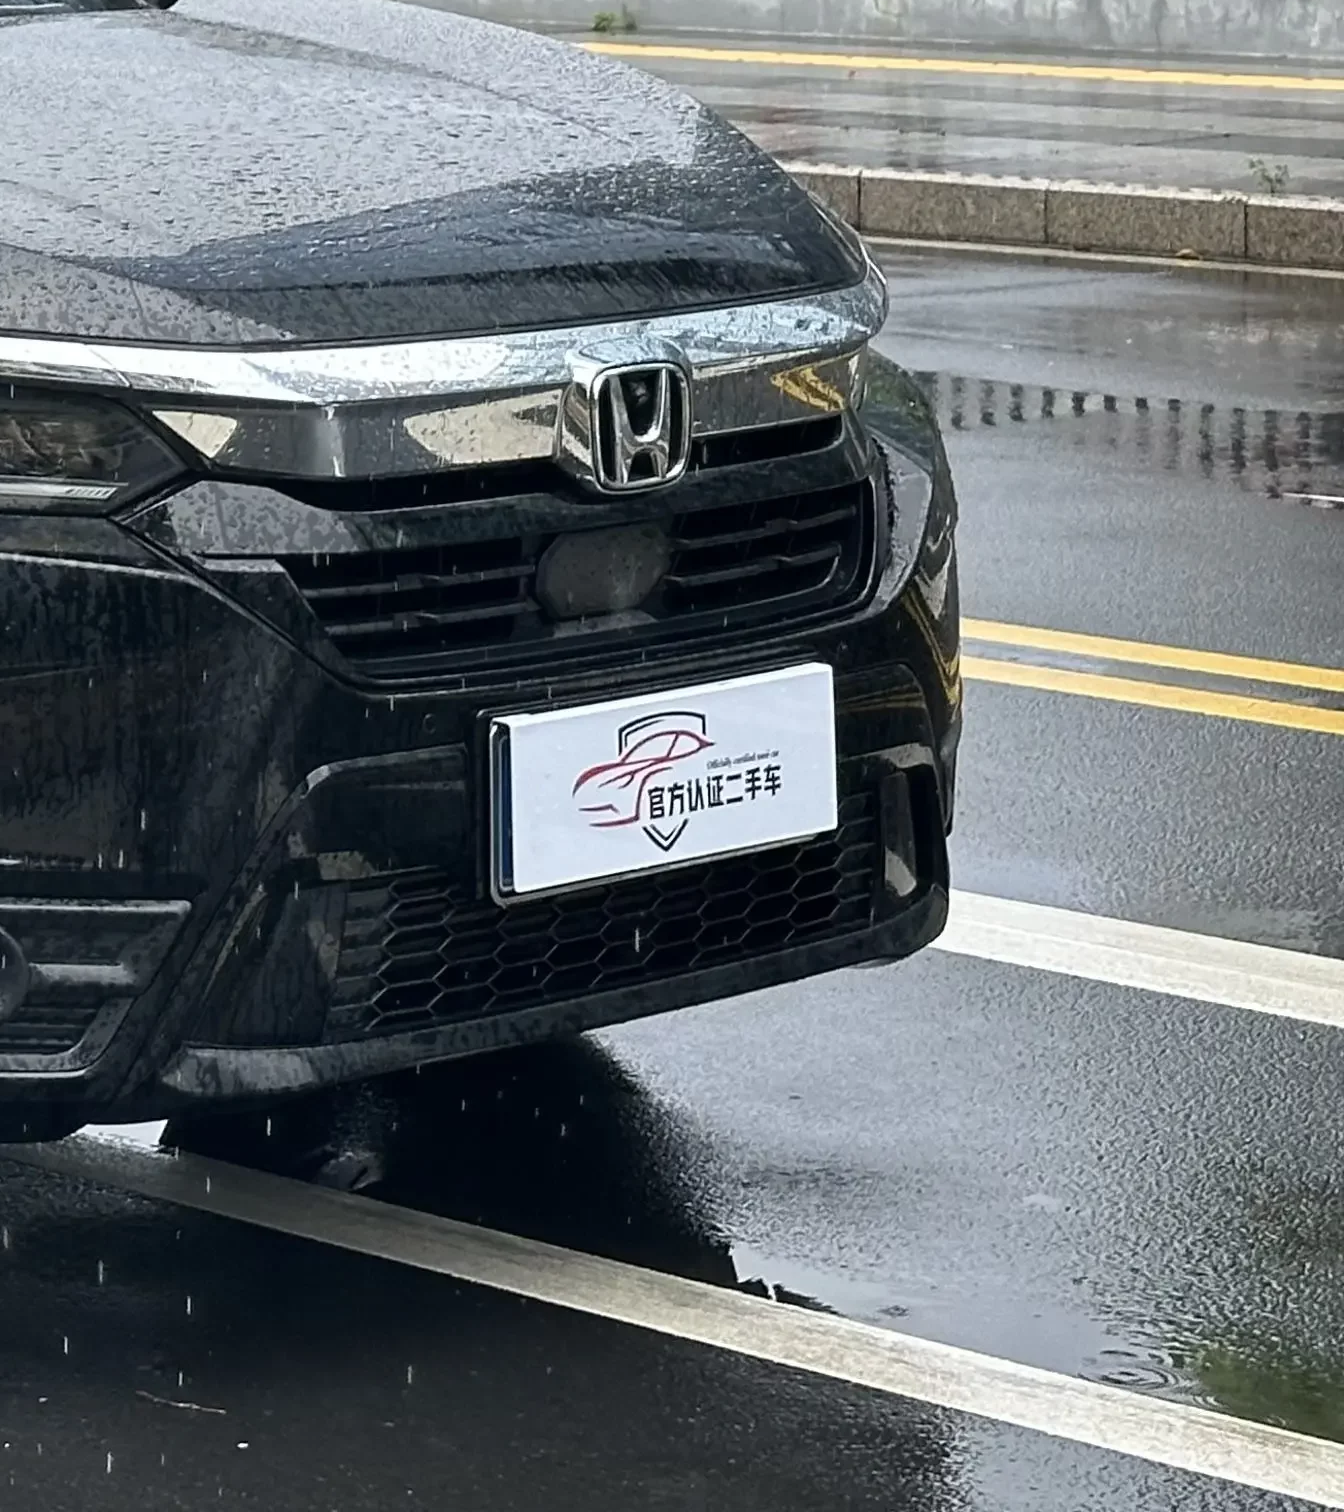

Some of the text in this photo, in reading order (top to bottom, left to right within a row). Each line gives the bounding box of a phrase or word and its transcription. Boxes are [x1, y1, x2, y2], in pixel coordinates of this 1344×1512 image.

[647, 764, 782, 820] 官方认证二手车
